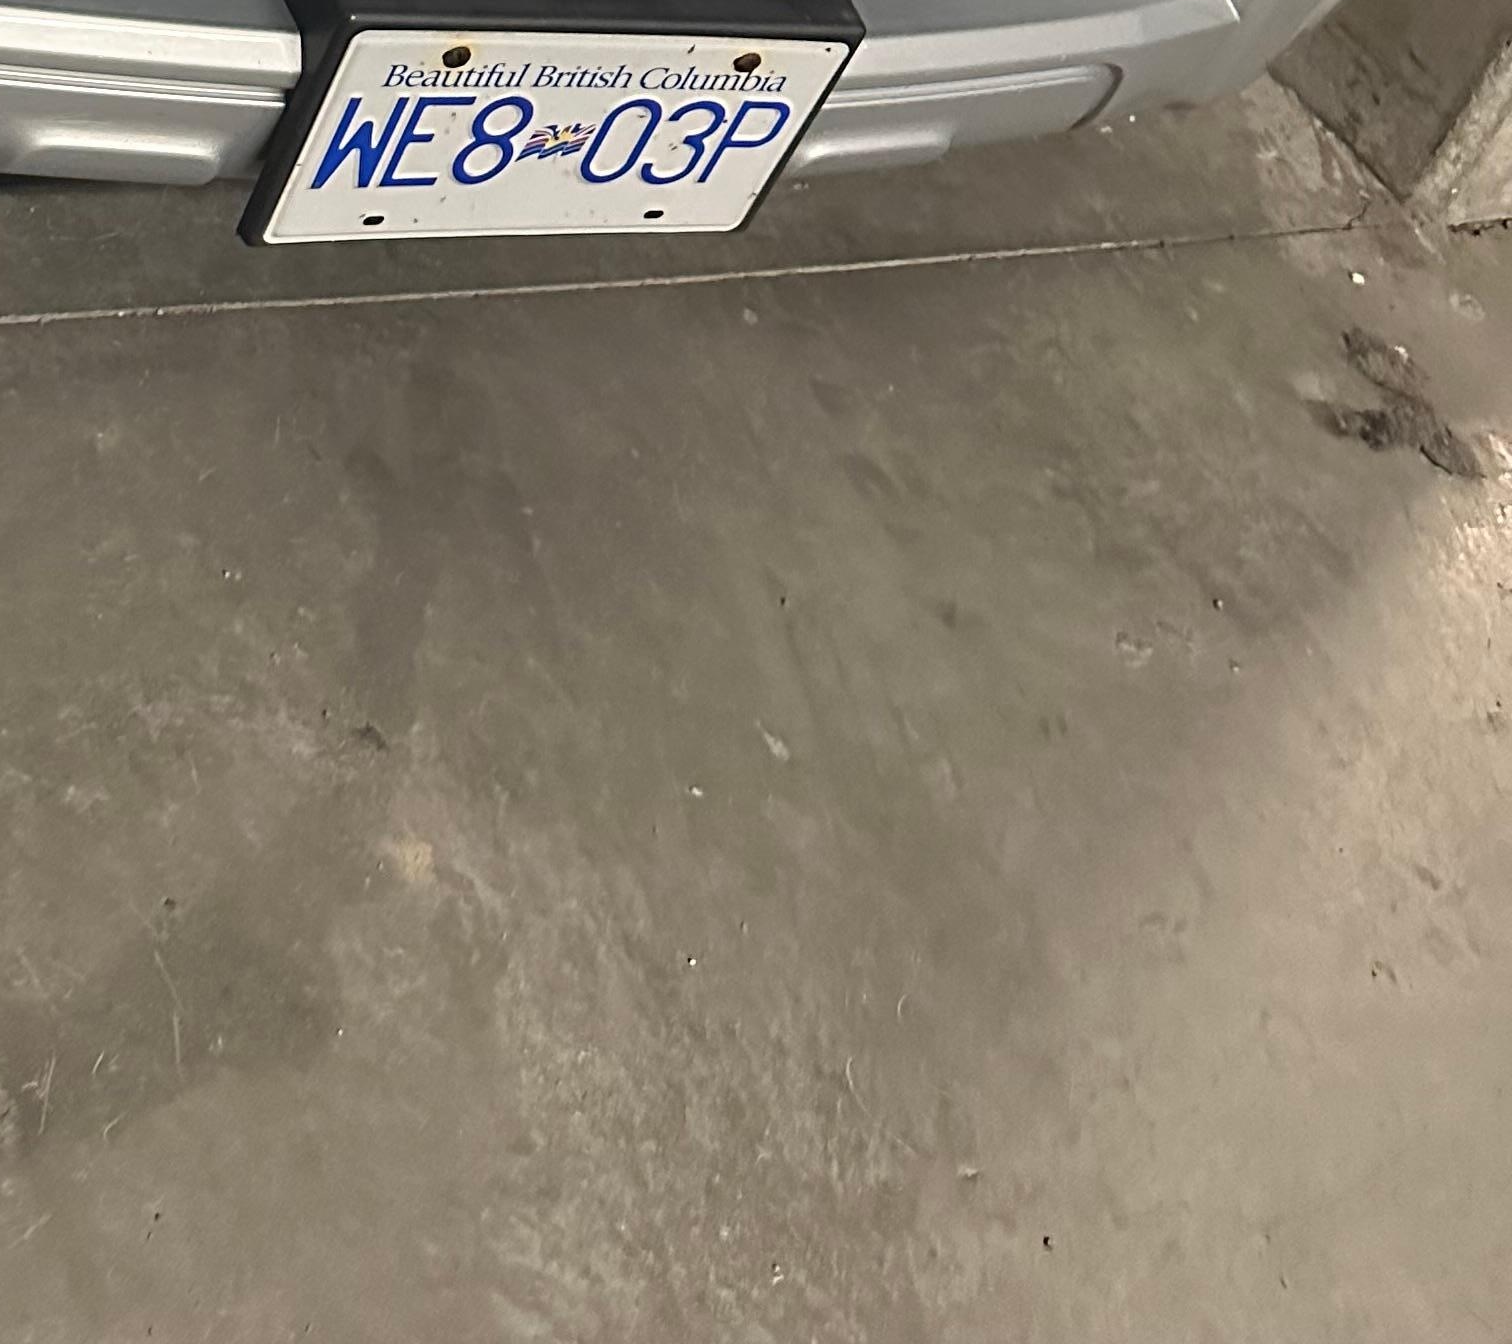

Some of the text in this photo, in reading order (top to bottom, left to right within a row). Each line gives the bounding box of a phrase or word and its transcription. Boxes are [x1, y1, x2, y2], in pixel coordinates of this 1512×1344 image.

[381, 62, 787, 93] Beautiful British Columbia
[310, 96, 790, 189] WE8 03P
